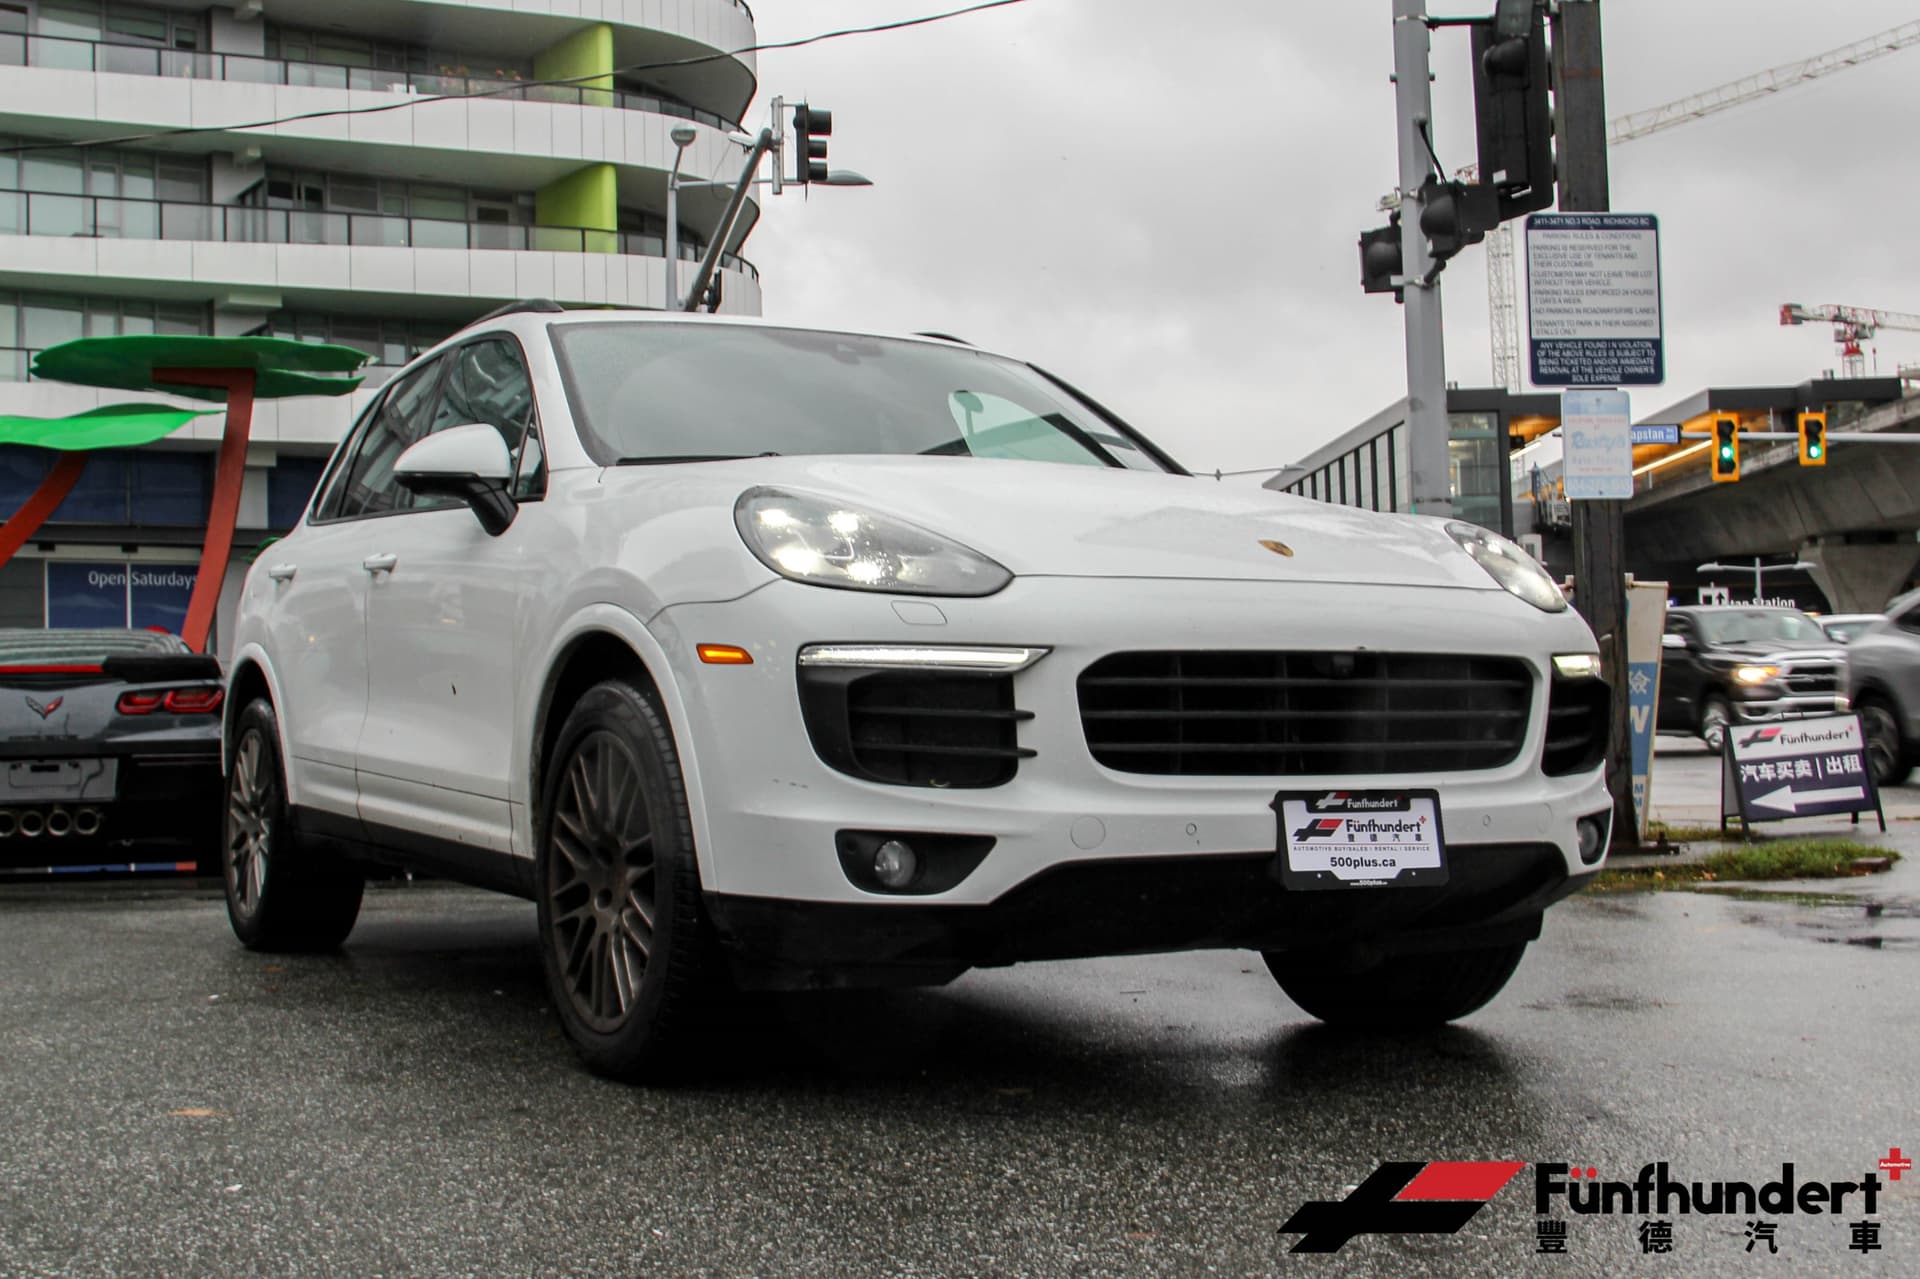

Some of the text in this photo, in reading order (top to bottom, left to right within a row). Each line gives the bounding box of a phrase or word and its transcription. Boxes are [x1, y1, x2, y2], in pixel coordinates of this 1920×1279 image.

[1603, 217, 1639, 225] RICHMOND
[1540, 341, 1554, 349] ANY
[1555, 341, 1582, 349] VEHICLE
[1584, 341, 1607, 349] FOUND
[1548, 349, 1560, 357] THE
[1562, 349, 1583, 357] ABOVE
[1585, 349, 1607, 357] RULES
[1616, 349, 1645, 357] SUBJECT
[1647, 349, 1656, 357] TO
[1538, 357, 1559, 365] BEING
[1561, 357, 1592, 365] TICKETED
[1540, 366, 1570, 374] REMOVAL
[1572, 366, 1579, 374] AT
[1581, 366, 1593, 374] THE
[1595, 366, 1622, 374] VEHICLE
[1572, 374, 1589, 382] SOLE
[1632, 428, 1664, 442] apstan
[88, 570, 126, 589] Open
[1741, 754, 1863, 783] 汽车买卖 出租
[1346, 819, 1421, 833] Fünfhundert
[1330, 857, 1396, 869] 500plus.ca
